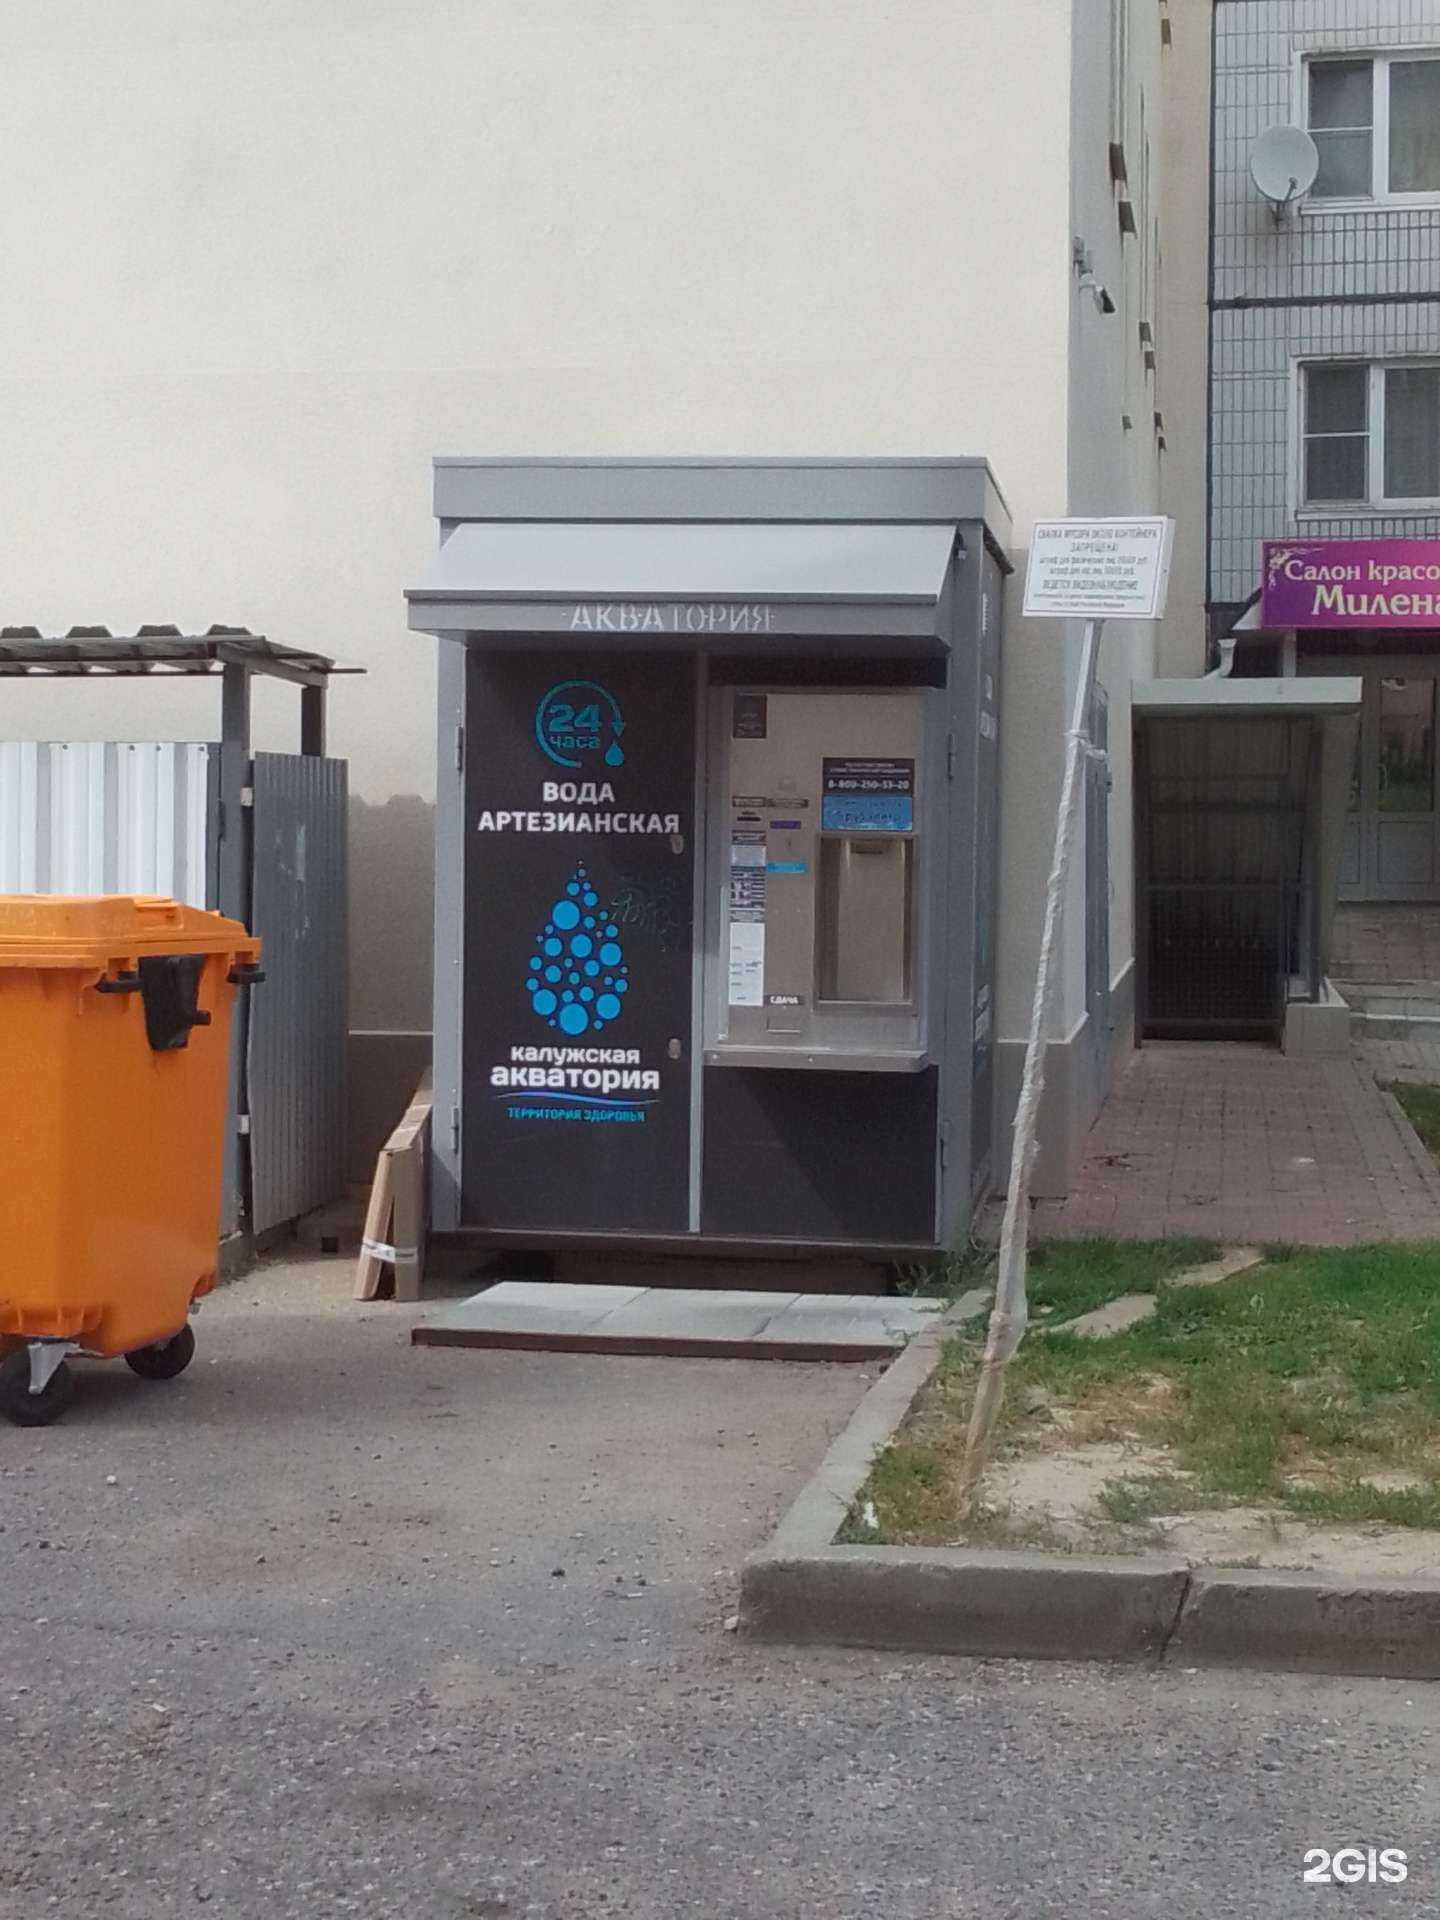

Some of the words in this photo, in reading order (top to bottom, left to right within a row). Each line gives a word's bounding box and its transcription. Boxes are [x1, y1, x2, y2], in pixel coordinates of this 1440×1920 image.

[1284, 560, 1361, 581] Салон
[570, 603, 771, 631] АКВАТОРИЯ
[548, 704, 602, 732] 24
[550, 736, 600, 749] часа
[542, 782, 615, 804] ВОДА
[477, 811, 680, 833] АРТЕЗИАНСКАЯ
[511, 1046, 640, 1066] калужская
[490, 1066, 660, 1093] акватория
[508, 1107, 582, 1121] ТЕРРИТОРИЯ
[583, 1109, 645, 1123] ЗДОРОВЬЯ
